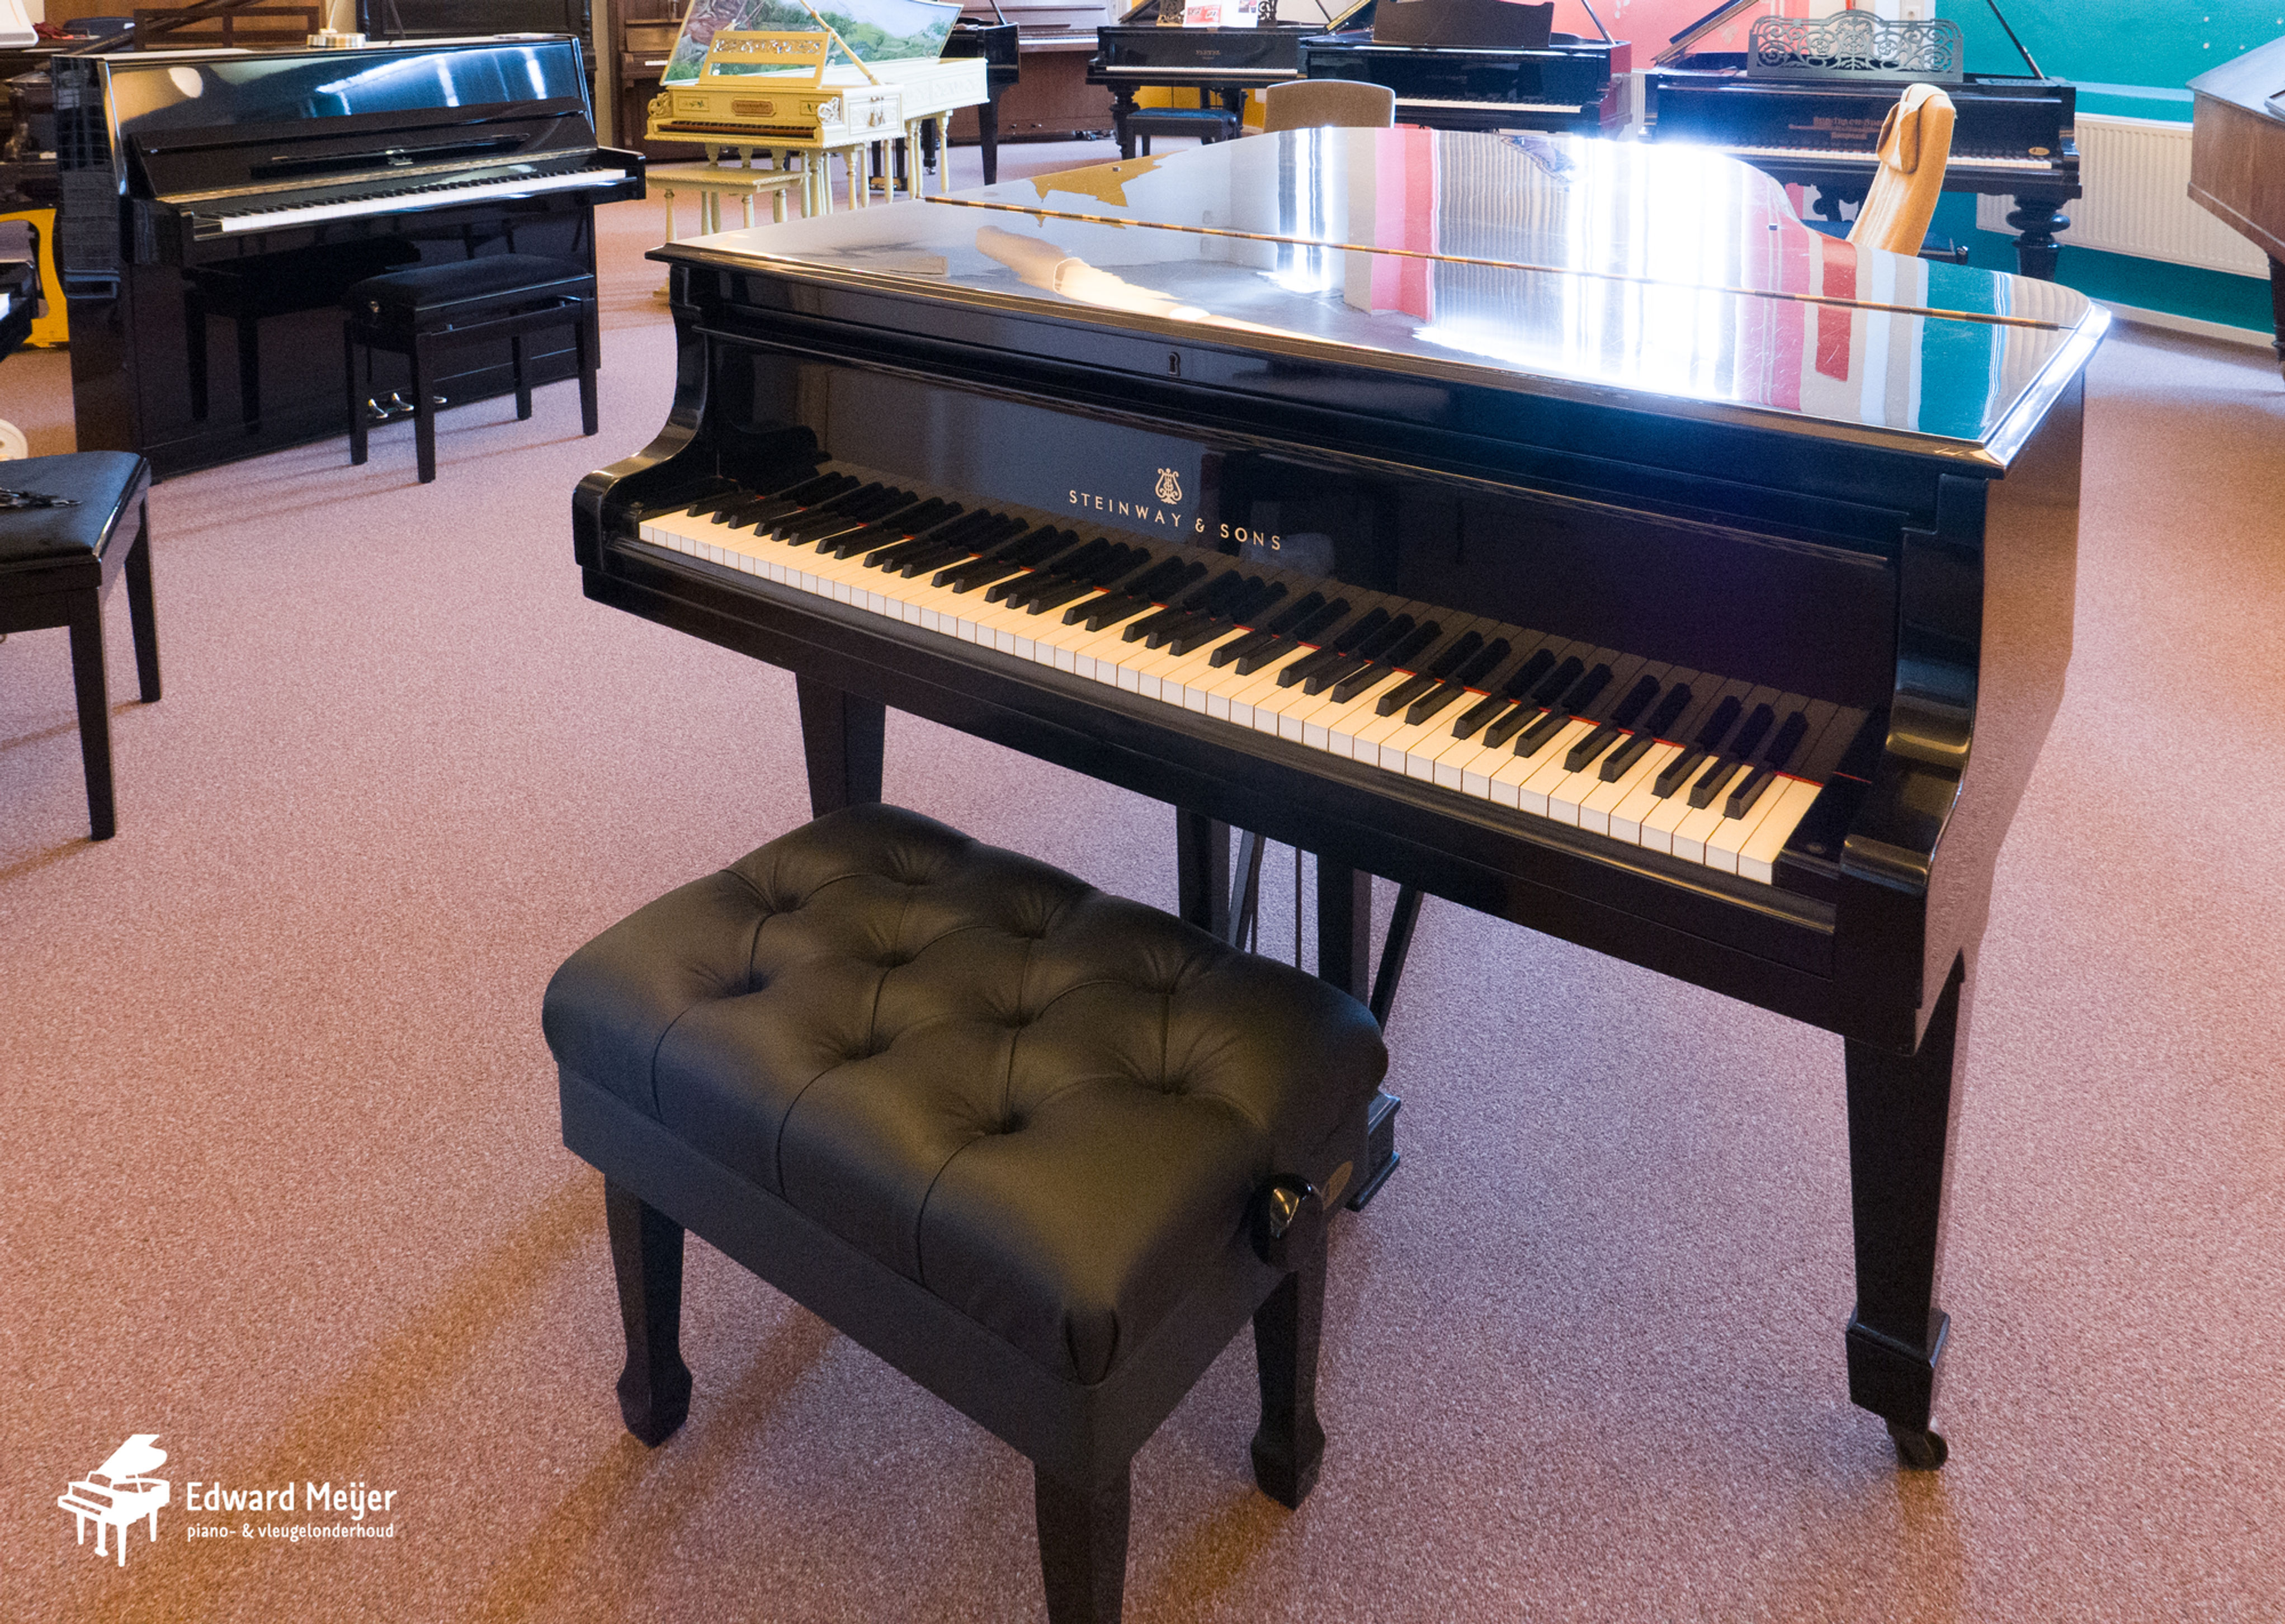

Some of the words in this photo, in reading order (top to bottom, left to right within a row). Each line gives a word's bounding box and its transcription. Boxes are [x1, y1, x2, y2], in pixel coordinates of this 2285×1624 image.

[1069, 490, 1181, 527] STEINWAY
[1195, 518, 1205, 533] &
[1220, 523, 1281, 550] SONS
